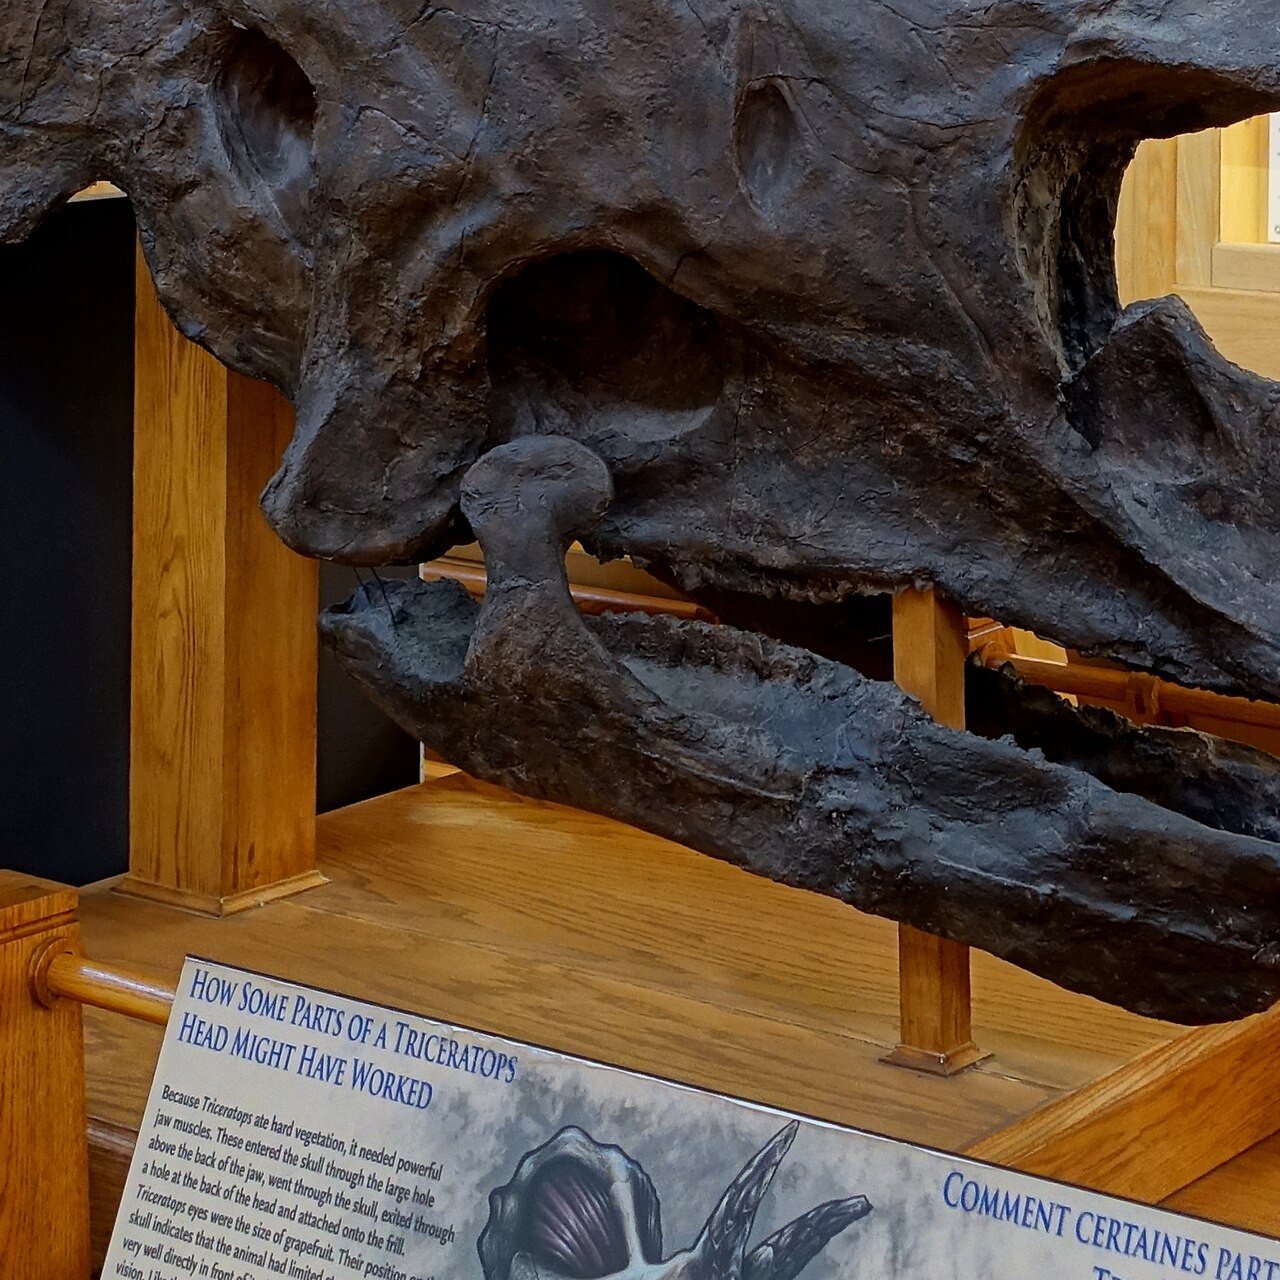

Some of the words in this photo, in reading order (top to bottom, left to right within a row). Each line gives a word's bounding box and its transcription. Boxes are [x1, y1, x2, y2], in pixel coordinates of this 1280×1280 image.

[177, 1012, 228, 1052] HEAD
[230, 1026, 297, 1071] MIGHT
[296, 1044, 347, 1086] HAVE
[352, 1058, 433, 1110] WORKED
[189, 968, 239, 1007] HOW
[238, 981, 289, 1022] SOME
[290, 995, 345, 1037] PARTS
[348, 1014, 374, 1043] OF
[374, 1022, 387, 1049] A
[394, 1021, 518, 1084] TRICERATOPS
[153, 1108, 173, 1128] jaw
[172, 1118, 212, 1141] muscles.
[216, 1127, 244, 1150] These
[245, 1140, 283, 1161] entered
[282, 1147, 299, 1166] the
[300, 1153, 325, 1174] skull
[325, 1160, 365, 1189] through
[366, 1172, 384, 1192] the
[385, 1177, 411, 1204] large
[411, 1185, 435, 1208] hole
[162, 1084, 200, 1109] Because
[202, 1096, 253, 1127] Triceratops
[254, 1114, 269, 1130] ate
[270, 1115, 295, 1137] hard
[295, 1127, 347, 1157] vegetation,
[349, 1138, 358, 1156] it
[358, 1147, 397, 1167] needed
[396, 1158, 444, 1182] powerful
[136, 1184, 187, 1216] Triceratops
[187, 1204, 209, 1222] eyes
[210, 1211, 233, 1229] were
[234, 1215, 251, 1235] the
[251, 1221, 271, 1241] size
[273, 1228, 287, 1245] of
[283, 1236, 334, 1262] grapefruit.
[338, 1248, 365, 1271] Their
[364, 1262, 407, 1280] position
[142, 1162, 149, 1174] a
[149, 1160, 170, 1181] hole
[171, 1170, 182, 1185] at
[182, 1171, 198, 1190] the
[199, 1175, 222, 1198] back
[223, 1184, 237, 1201] of
[234, 1187, 251, 1207] the
[252, 1191, 278, 1215] head
[277, 1204, 298, 1221] and
[298, 1211, 342, 1235] attached
[342, 1226, 365, 1243] onto
[366, 1229, 384, 1250] the
[385, 1234, 405, 1257] frill.
[148, 1134, 176, 1156] above
[177, 1142, 193, 1161] the
[194, 1146, 217, 1169] back
[217, 1156, 231, 1172] of
[229, 1158, 245, 1177] the
[244, 1163, 265, 1187] jaw,
[268, 1174, 293, 1192] went
[293, 1178, 333, 1208] through
[334, 1190, 351, 1210] the
[352, 1197, 378, 1223] skull,
[381, 1207, 414, 1230] exited
[413, 1215, 455, 1245] through
[943, 1170, 1071, 1236] COMMENT
[1075, 1211, 1208, 1275] CERTAINES
[123, 1237, 142, 1258] very
[143, 1243, 164, 1261] well
[163, 1247, 198, 1276] directly
[198, 1258, 209, 1277] in
[210, 1262, 234, 1280] front
[128, 1209, 153, 1229] skull
[152, 1215, 194, 1243] indicates
[195, 1229, 215, 1250] that
[216, 1236, 232, 1256] the
[233, 1245, 268, 1267] animal
[267, 1252, 288, 1274] had
[288, 1259, 324, 1280] limited
